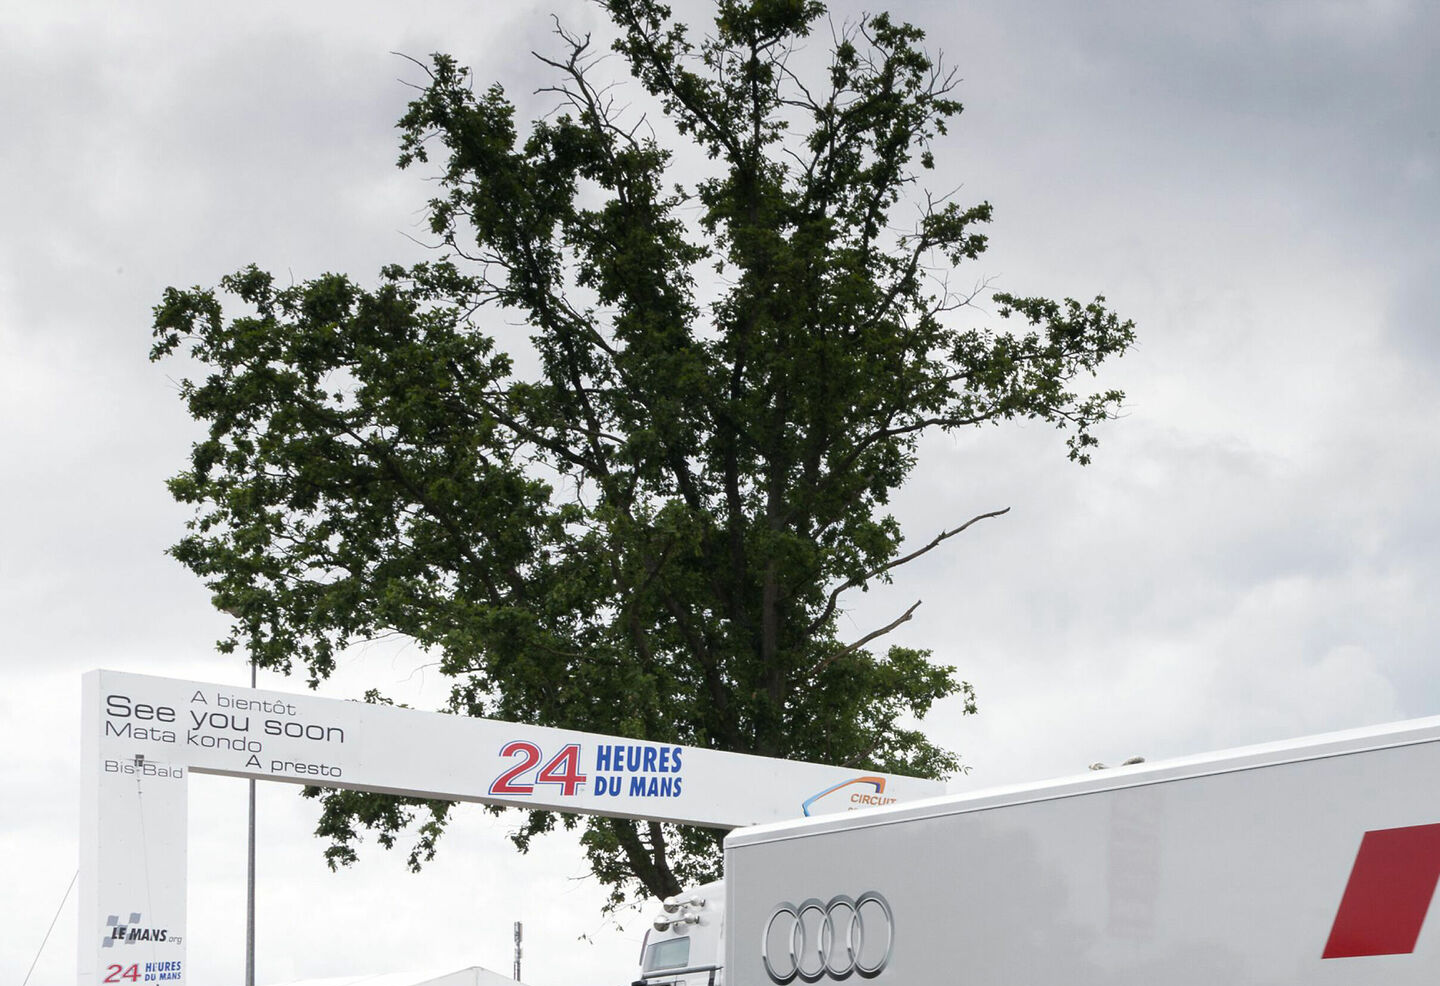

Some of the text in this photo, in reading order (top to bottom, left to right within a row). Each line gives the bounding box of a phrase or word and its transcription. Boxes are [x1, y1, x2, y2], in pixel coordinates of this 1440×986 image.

[190, 690, 296, 716] A bientôt
[106, 694, 344, 743] See you soon
[105, 720, 263, 753] Mata kondo
[105, 760, 183, 778] Bis Bald
[245, 754, 342, 778] A presto
[488, 739, 588, 796] 24
[596, 744, 683, 773] HEURES
[594, 776, 682, 797] DU MANS
[111, 927, 127, 940] LE
[103, 963, 142, 983] 24
[144, 972, 181, 981] DU MANS
